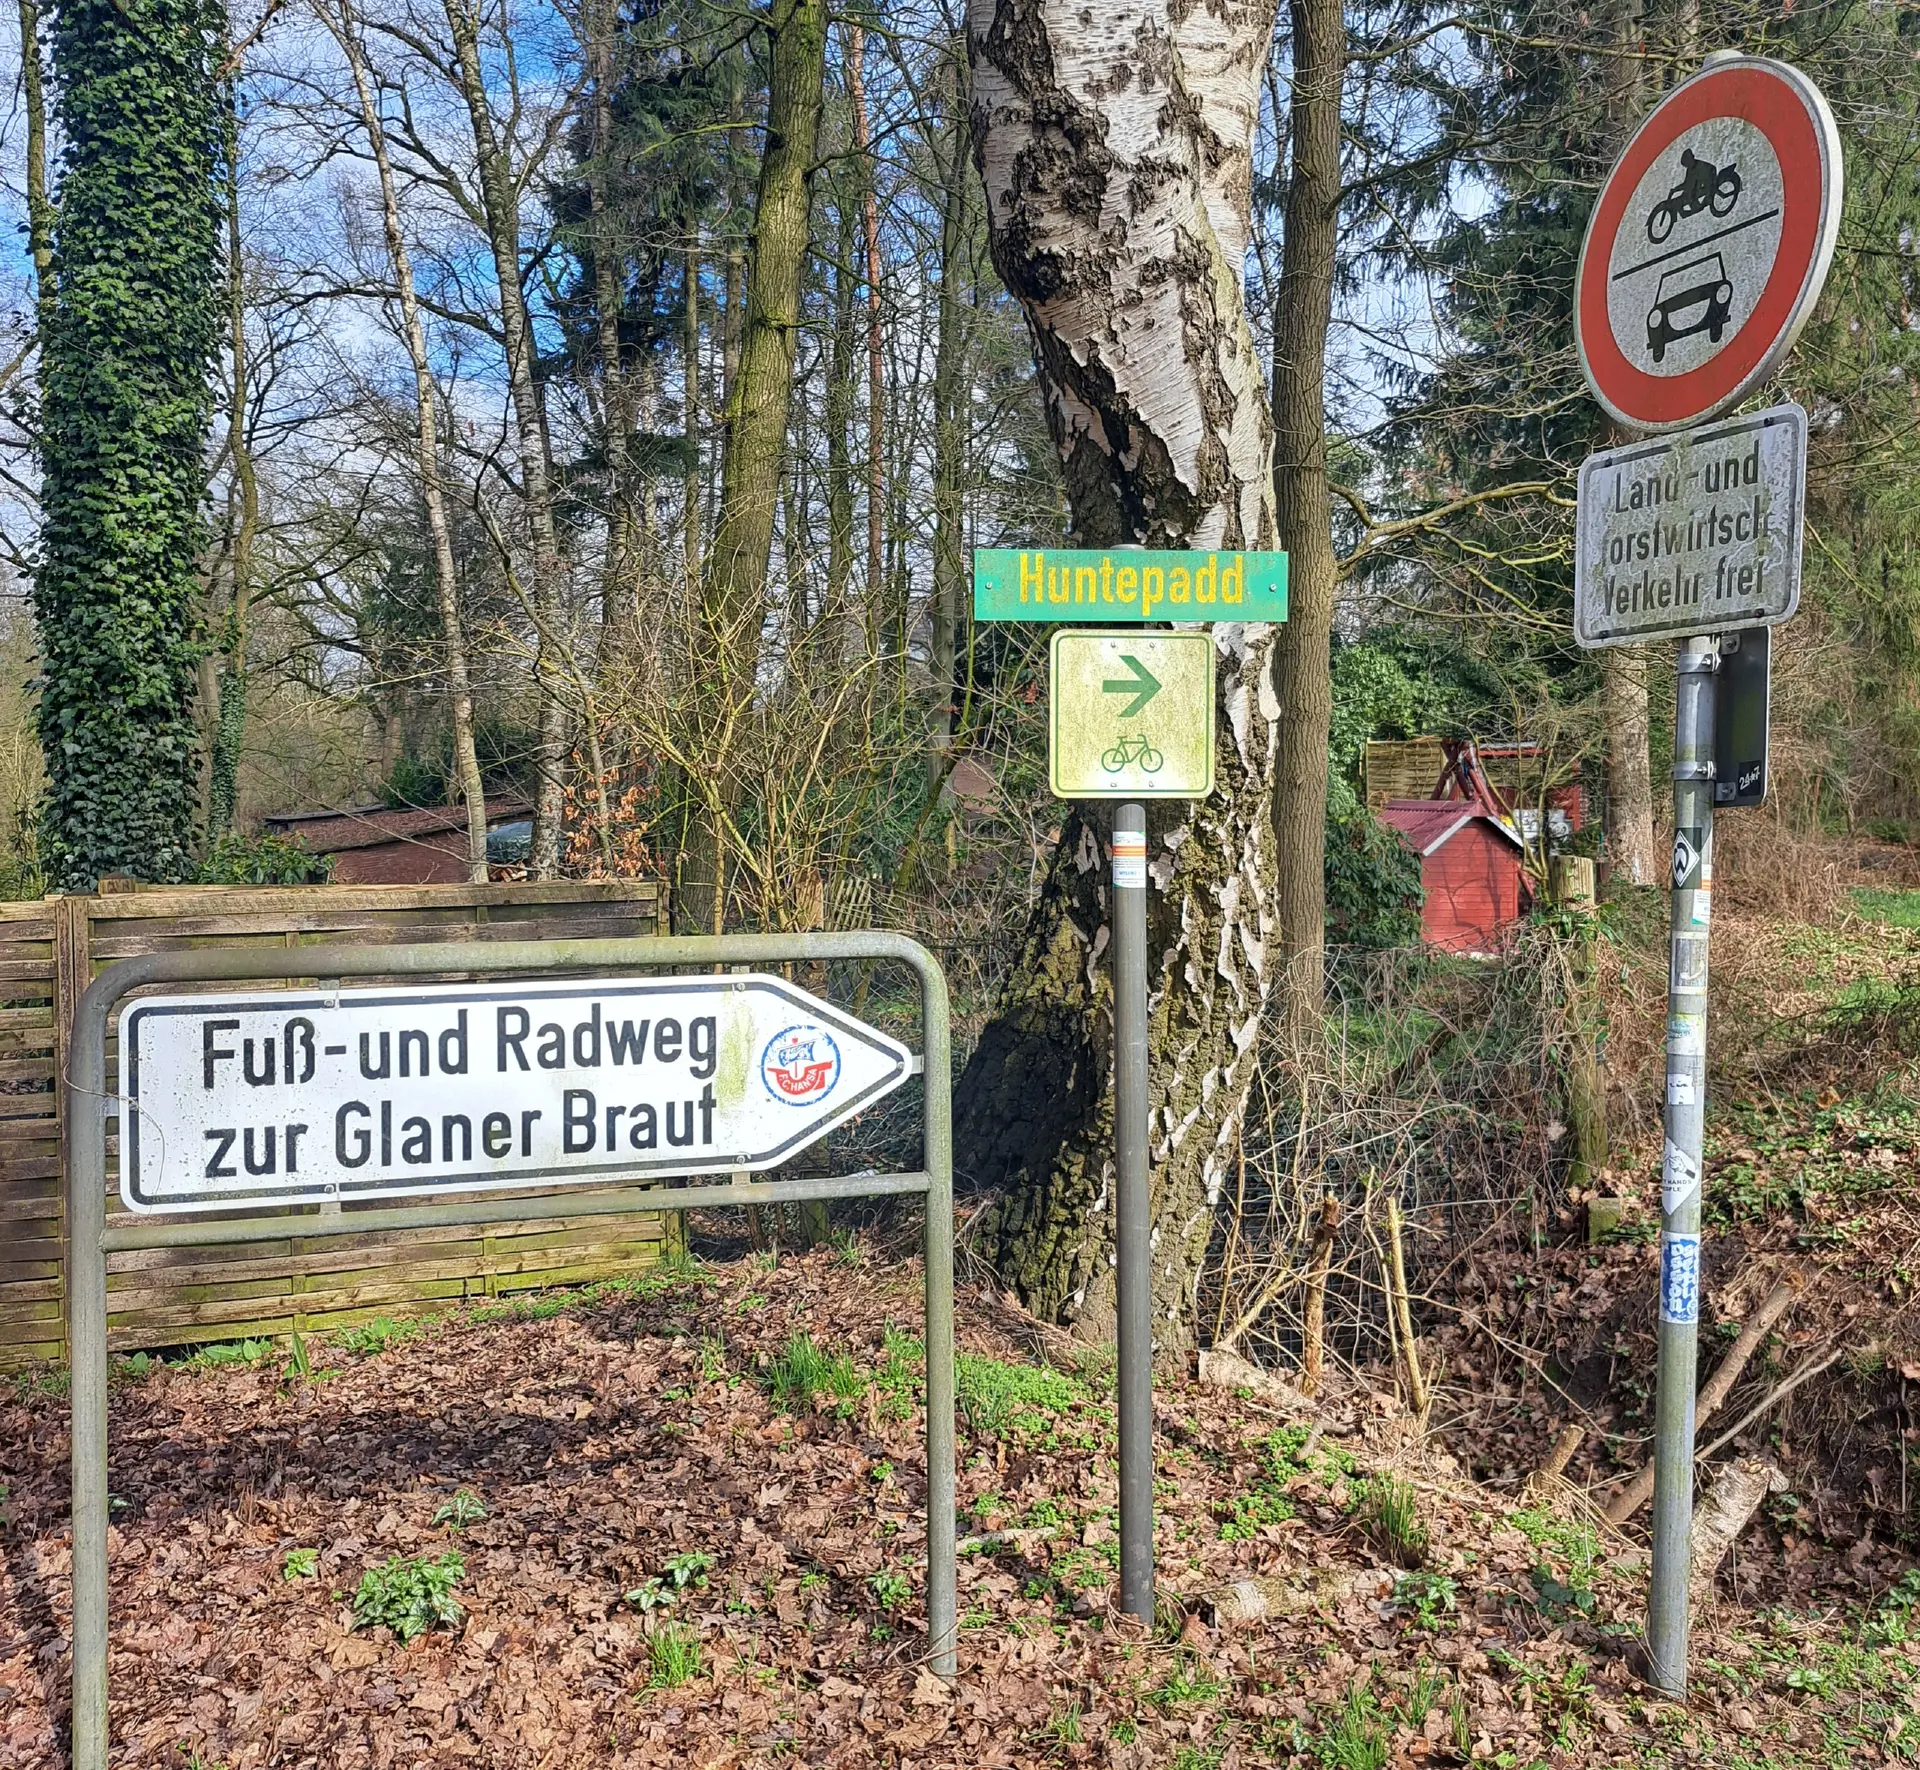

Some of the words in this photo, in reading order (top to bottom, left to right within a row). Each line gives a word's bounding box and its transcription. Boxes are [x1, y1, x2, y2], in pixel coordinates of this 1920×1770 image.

[1019, 552, 1244, 616] Huntepadd
[1603, 564, 1701, 616] Verkehr
[496, 1003, 717, 1080] Radweg
[204, 1123, 309, 1178] zur
[335, 1100, 543, 1169] Glaner
[563, 1082, 717, 1154] Braut
